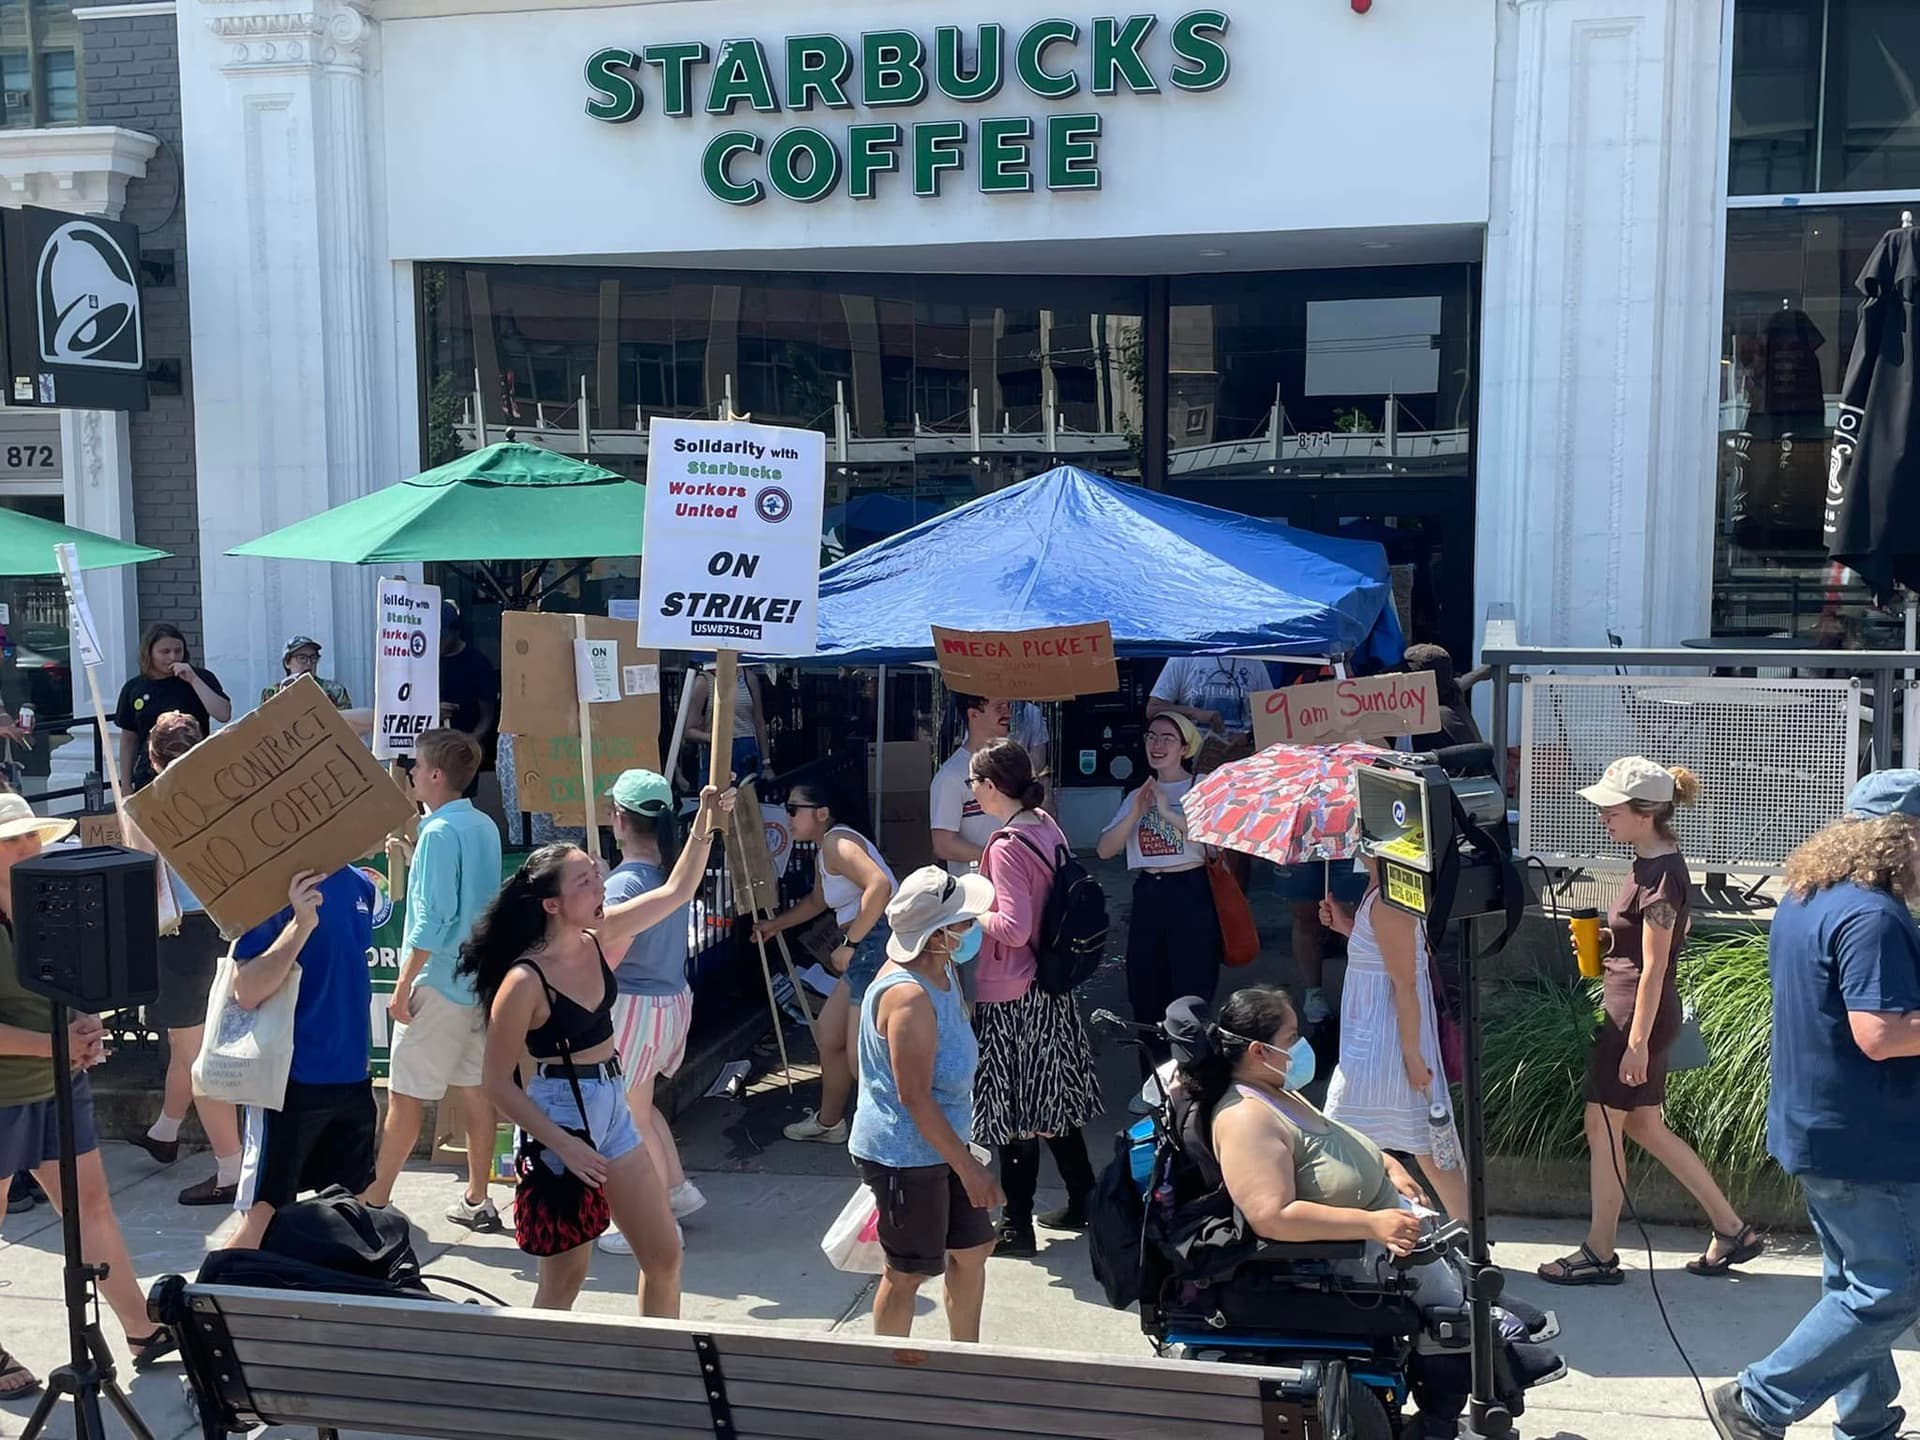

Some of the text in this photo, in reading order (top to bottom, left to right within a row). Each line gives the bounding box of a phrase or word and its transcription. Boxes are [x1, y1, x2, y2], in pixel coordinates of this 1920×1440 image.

[583, 8, 1230, 123] STARBUCKS
[700, 113, 1101, 205] COFFEE
[7, 446, 54, 467] 872
[674, 438, 798, 459] Solidarity with
[687, 461, 782, 480] Starbucks
[669, 482, 747, 498] Workers
[675, 503, 738, 518] United
[707, 551, 760, 579] ON
[660, 591, 802, 624] STRIKE!
[694, 624, 760, 639] USW8751.org
[591, 647, 607, 657] ON
[941, 635, 1104, 658] MEGA PICKET
[1265, 680, 1426, 739] 9 am Sunday
[152, 706, 326, 839] NO CONTRACT
[186, 744, 369, 896] NO COFFEE!
